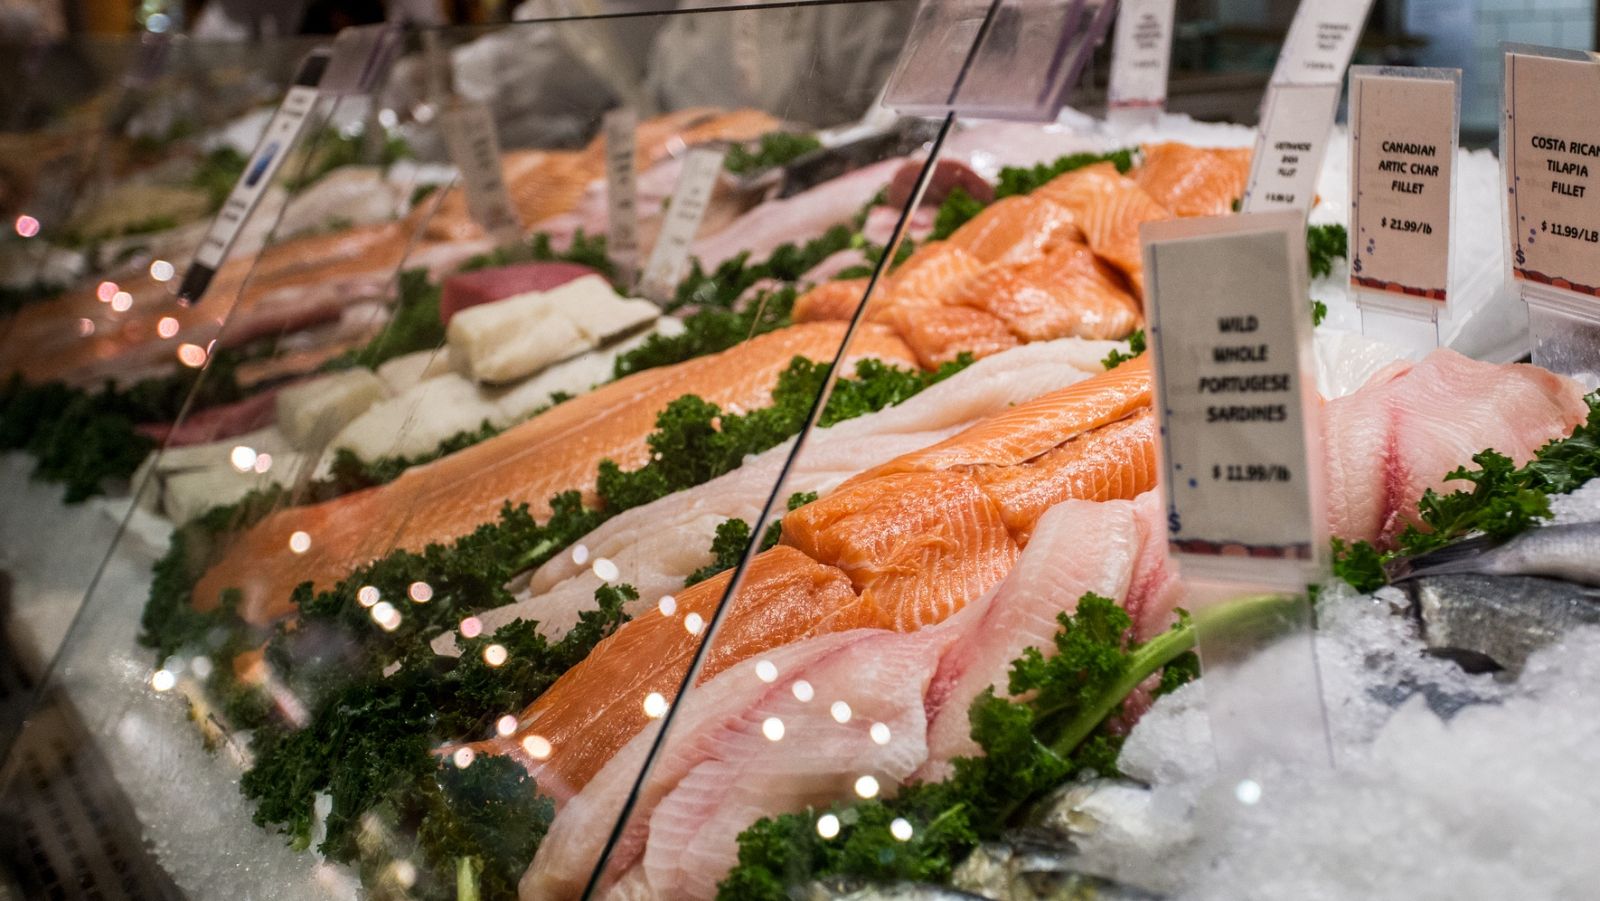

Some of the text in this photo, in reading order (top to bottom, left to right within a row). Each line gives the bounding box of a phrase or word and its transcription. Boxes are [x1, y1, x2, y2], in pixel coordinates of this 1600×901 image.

[1382, 141, 1436, 156] CANADIAN
[1532, 136, 1566, 152] COSTA
[1379, 160, 1440, 176] ARTIC CHAR
[1547, 159, 1588, 177] TILAPIA
[1392, 180, 1424, 195] FILLET
[1552, 181, 1585, 198] FILLET
[1380, 217, 1432, 234] $ 21.99/lb
[1541, 220, 1599, 243] $ 11.99/LB
[1218, 315, 1258, 333] WILD
[1213, 344, 1267, 363] WHOLE
[1198, 374, 1290, 394] PORTUGESE
[1206, 405, 1287, 423] SARDINES
